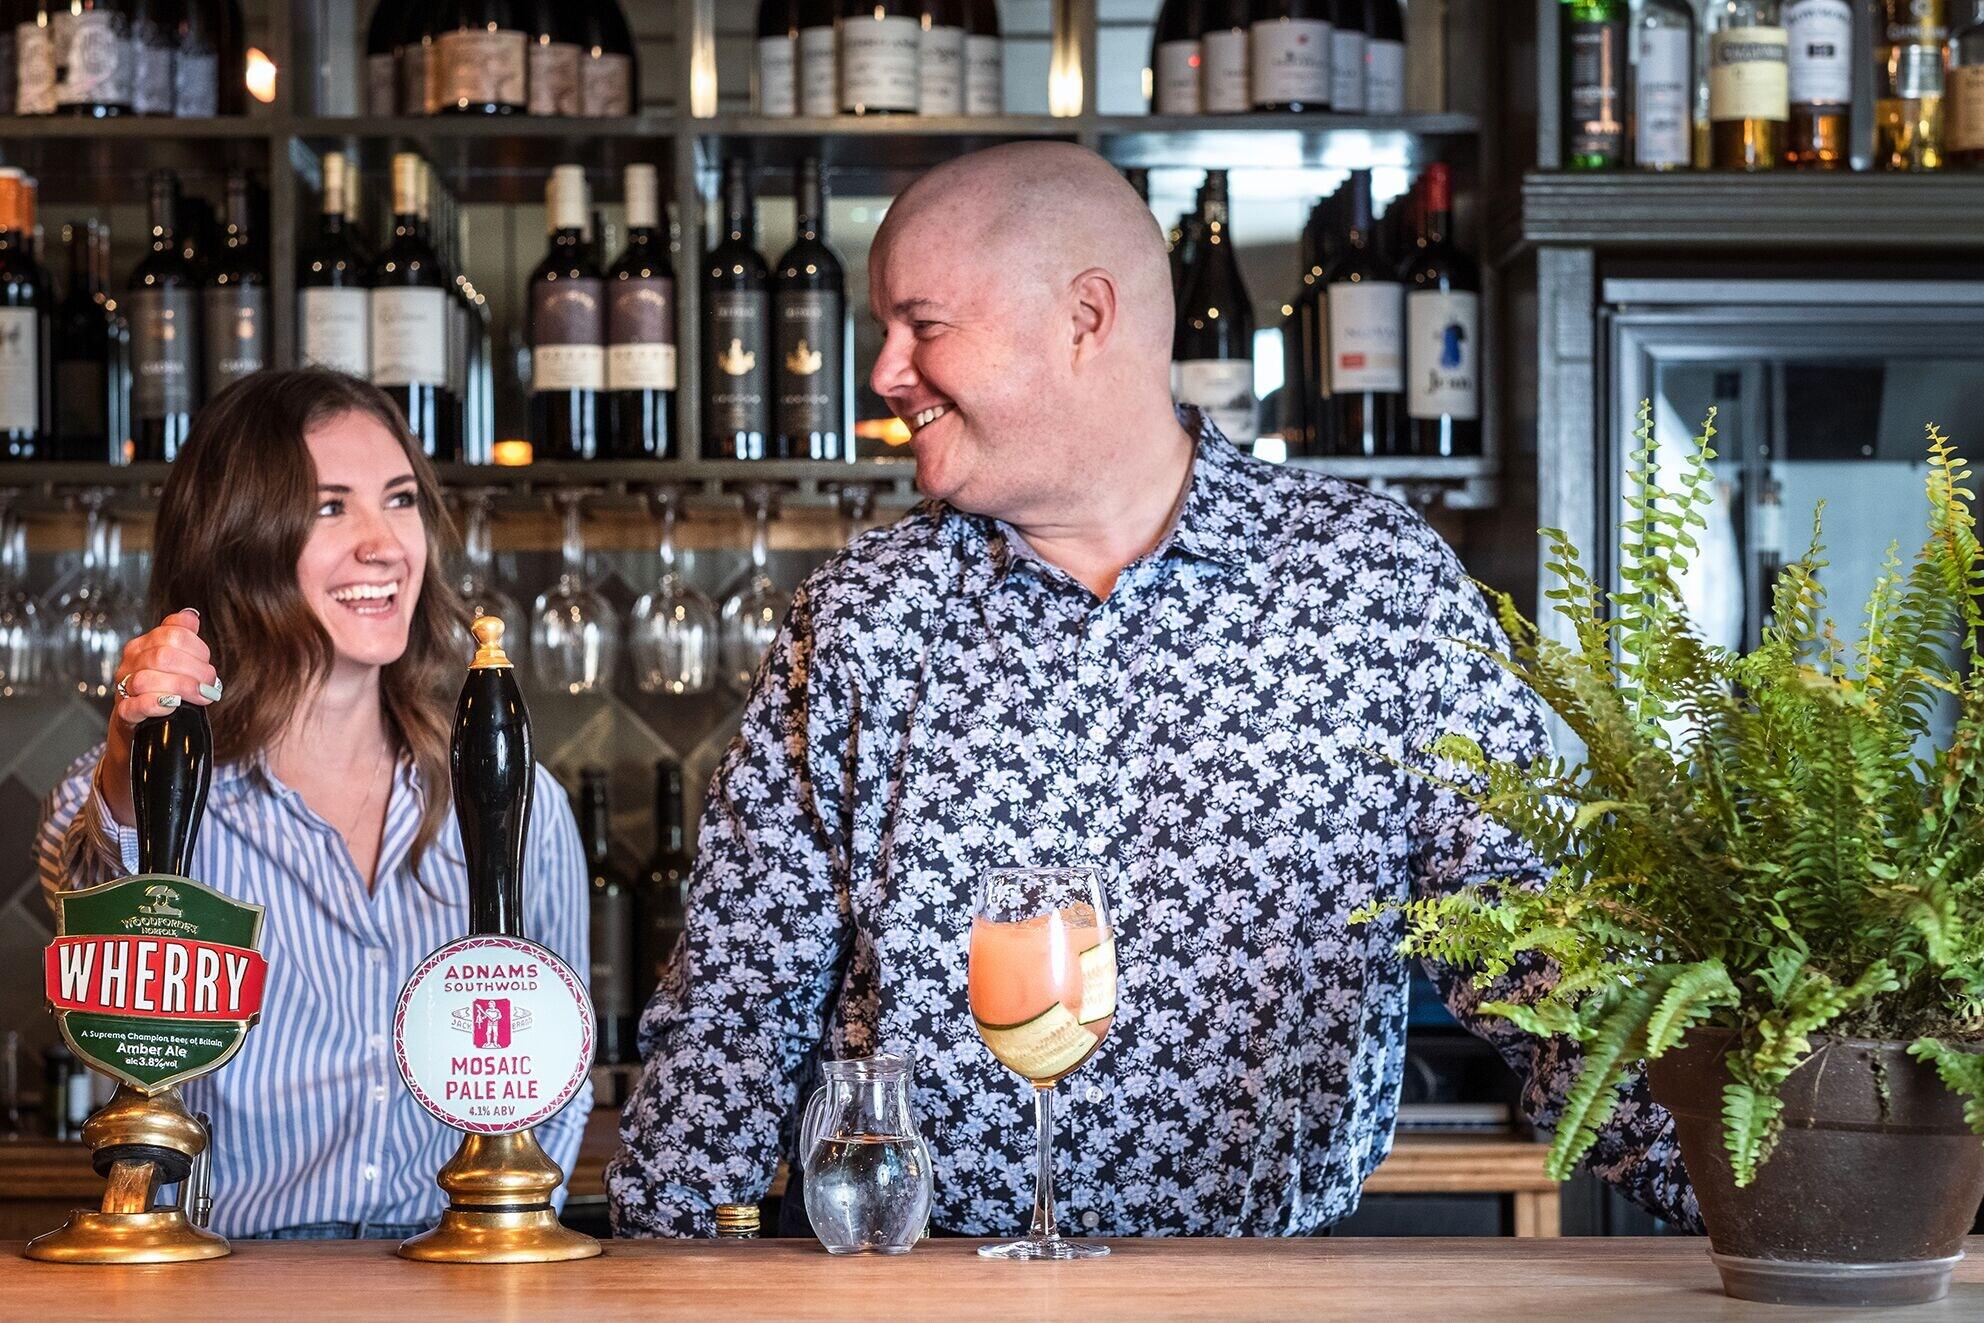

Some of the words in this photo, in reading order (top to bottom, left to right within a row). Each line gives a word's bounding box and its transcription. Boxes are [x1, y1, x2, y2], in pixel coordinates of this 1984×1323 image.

[141, 927, 178, 937] NORFOLK
[58, 941, 250, 1013] WHERRY
[444, 964, 538, 979] ADNAMS
[444, 981, 538, 992] SOUTHWOLD
[451, 1018, 472, 1030] JACK
[89, 1031, 126, 1040] Supreme
[128, 1033, 169, 1042] Champion
[170, 1035, 188, 1044] Beer
[190, 1037, 198, 1045] of
[199, 1038, 223, 1047] Britain
[116, 1042, 162, 1055] Amber
[165, 1045, 188, 1058] Ale
[451, 1056, 532, 1075] MOSAIC
[446, 1081, 496, 1100] PALE
[503, 1080, 538, 1099] ALE
[469, 1106, 491, 1116] 4.1%
[493, 1106, 516, 1116] ABV
